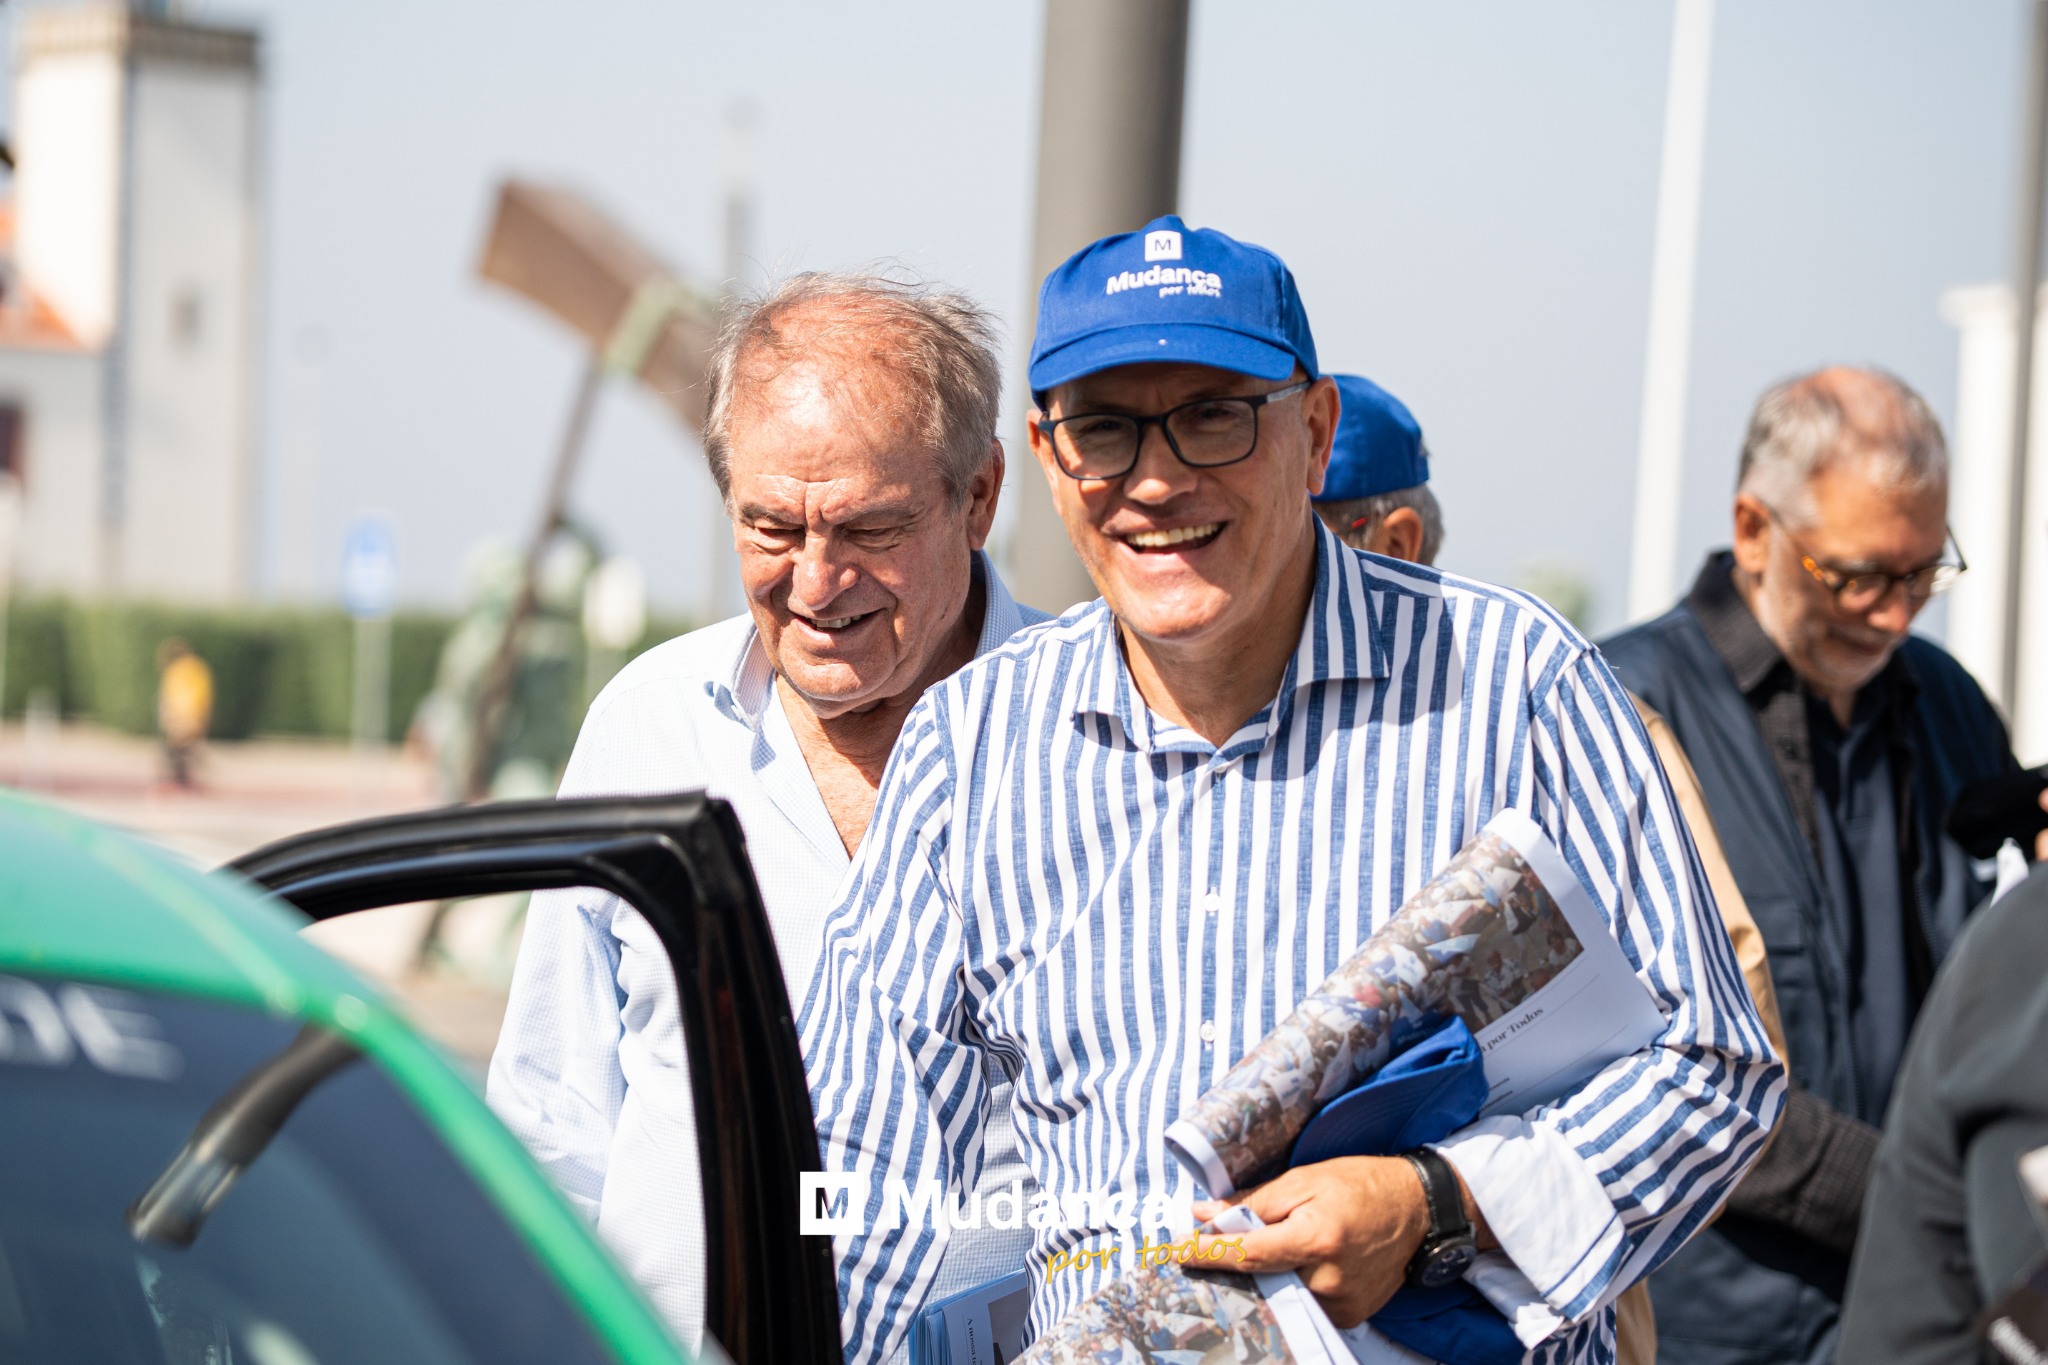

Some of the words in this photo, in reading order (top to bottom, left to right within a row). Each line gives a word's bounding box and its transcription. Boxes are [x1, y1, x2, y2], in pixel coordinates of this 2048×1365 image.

[1154, 238, 1172, 252] M
[1106, 264, 1222, 296] Mudança
[1158, 285, 1184, 298] por
[1486, 1030, 1508, 1051] por
[1507, 1007, 1544, 1033] Todos
